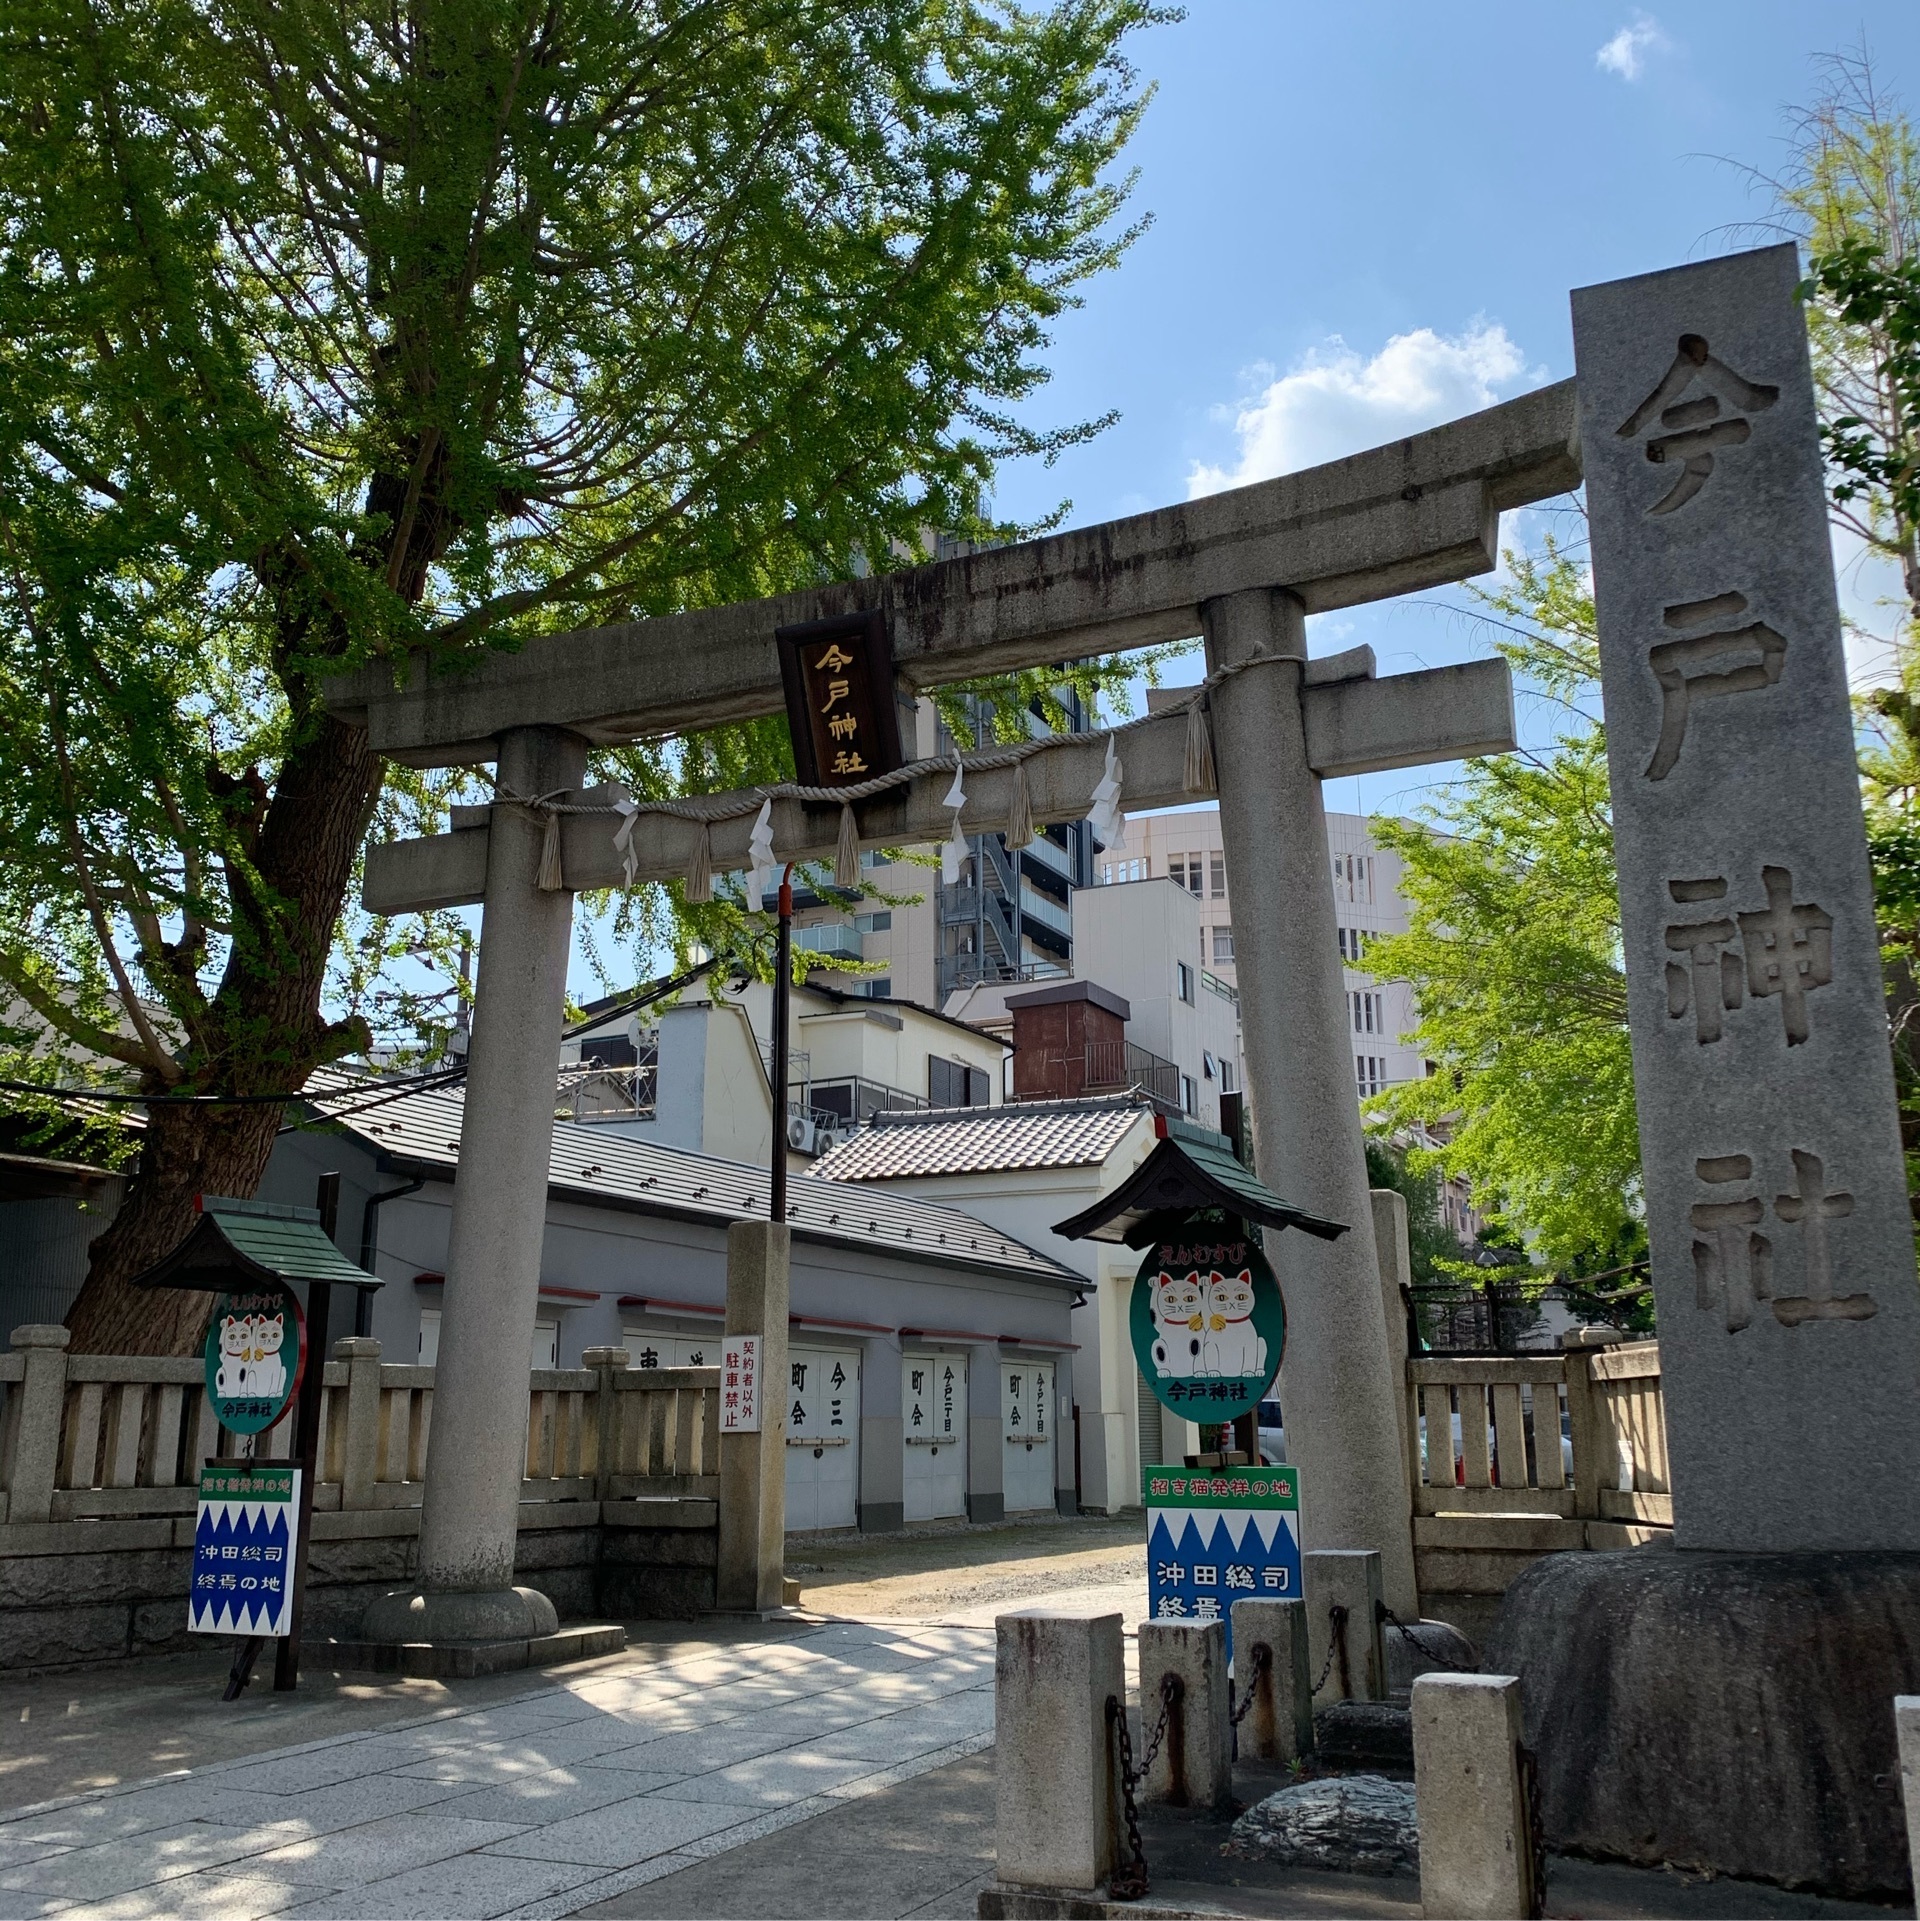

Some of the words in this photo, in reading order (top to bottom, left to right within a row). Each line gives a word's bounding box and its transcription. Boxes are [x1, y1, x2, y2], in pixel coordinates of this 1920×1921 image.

[814, 644, 869, 775] 今戸神社
[1615, 333, 1878, 1335] 今戸神社
[1158, 1242, 1247, 1267] えんむすび
[724, 1352, 740, 1428] 駐車禁止
[742, 1340, 755, 1419] 契約者以外
[790, 1362, 808, 1426] 町会
[830, 1361, 847, 1427] 今三
[911, 1369, 925, 1426] 町会
[943, 1365, 955, 1432] 今戸二丁目
[1009, 1374, 1022, 1426] 町会
[1166, 1380, 1249, 1402] 今戸神社
[222, 1401, 273, 1419] 今戸神社
[202, 1476, 292, 1493] 招き猫発祥の地
[1151, 1477, 1293, 1498] 招き猫発祥の地
[200, 1544, 283, 1562] 沖田総司
[1156, 1561, 1290, 1591] 沖田総司
[196, 1573, 282, 1593] 終焉の地
